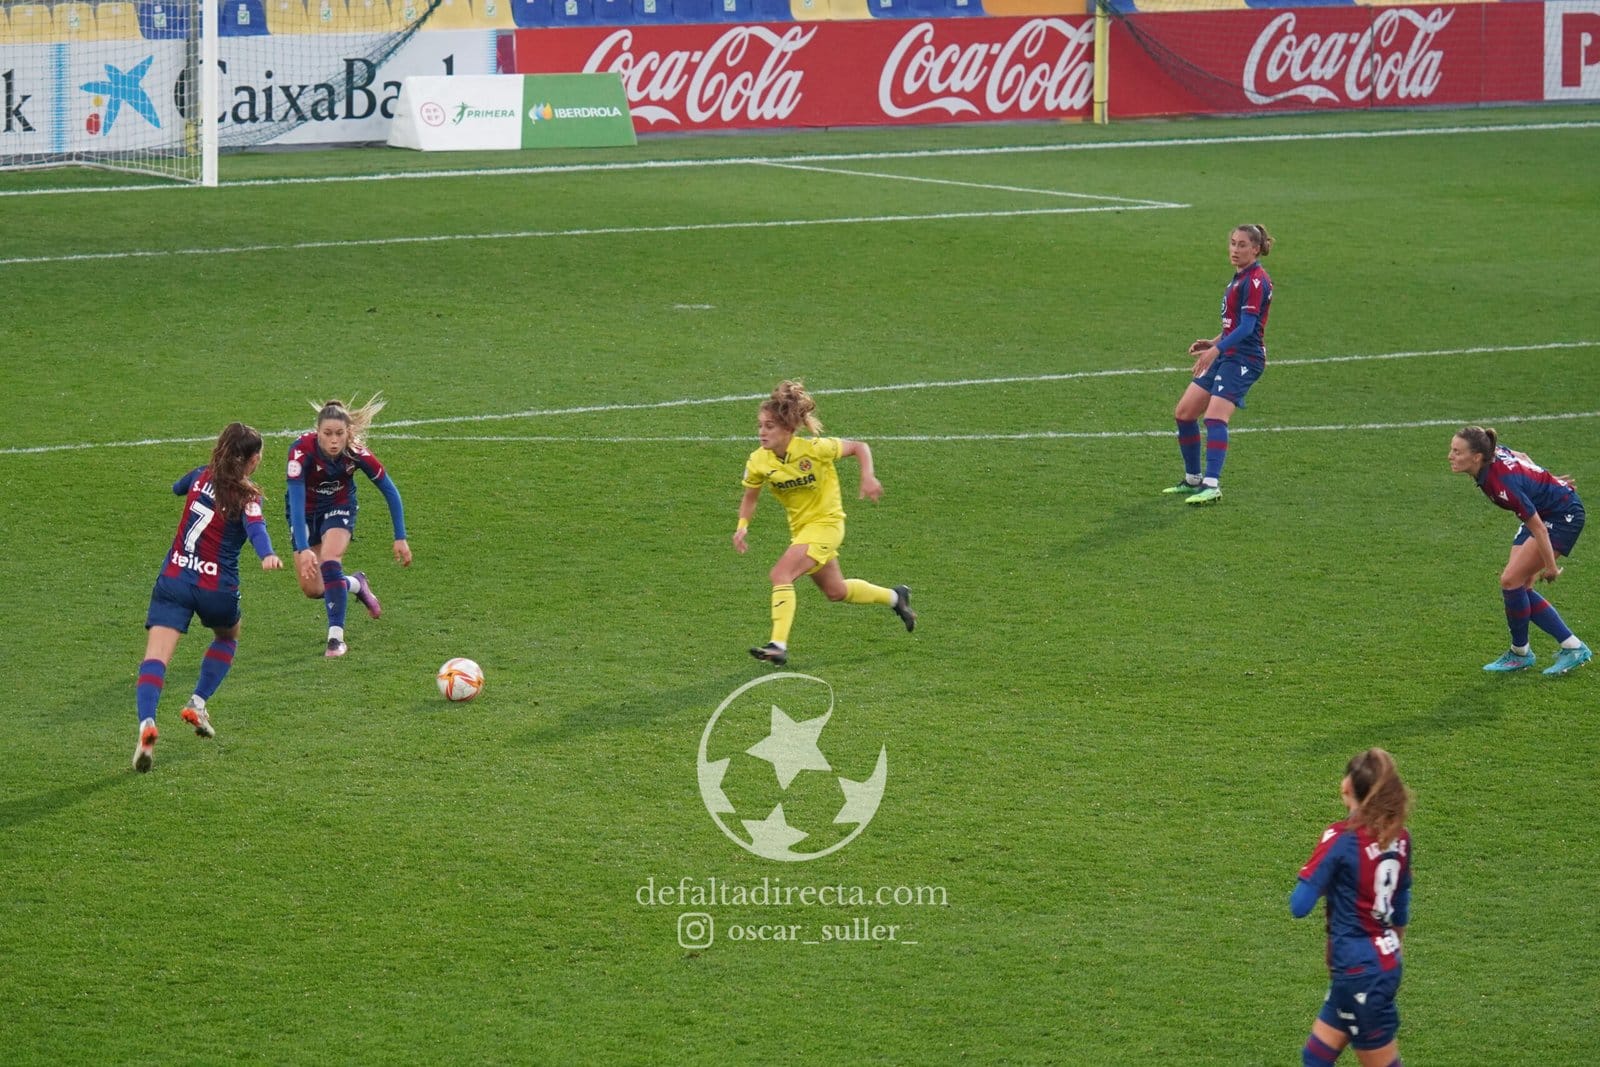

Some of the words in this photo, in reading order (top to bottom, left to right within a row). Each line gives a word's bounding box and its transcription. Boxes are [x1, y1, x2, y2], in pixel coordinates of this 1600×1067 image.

[582, 25, 818, 125] Coca-Cola
[878, 17, 1096, 119] Coca-Cola
[1242, 7, 1455, 105] Coca-Cola
[466, 109, 516, 120] PRIMERA
[554, 106, 623, 120] IBERDROLA
[184, 502, 215, 553] 7
[171, 550, 218, 576] teika
